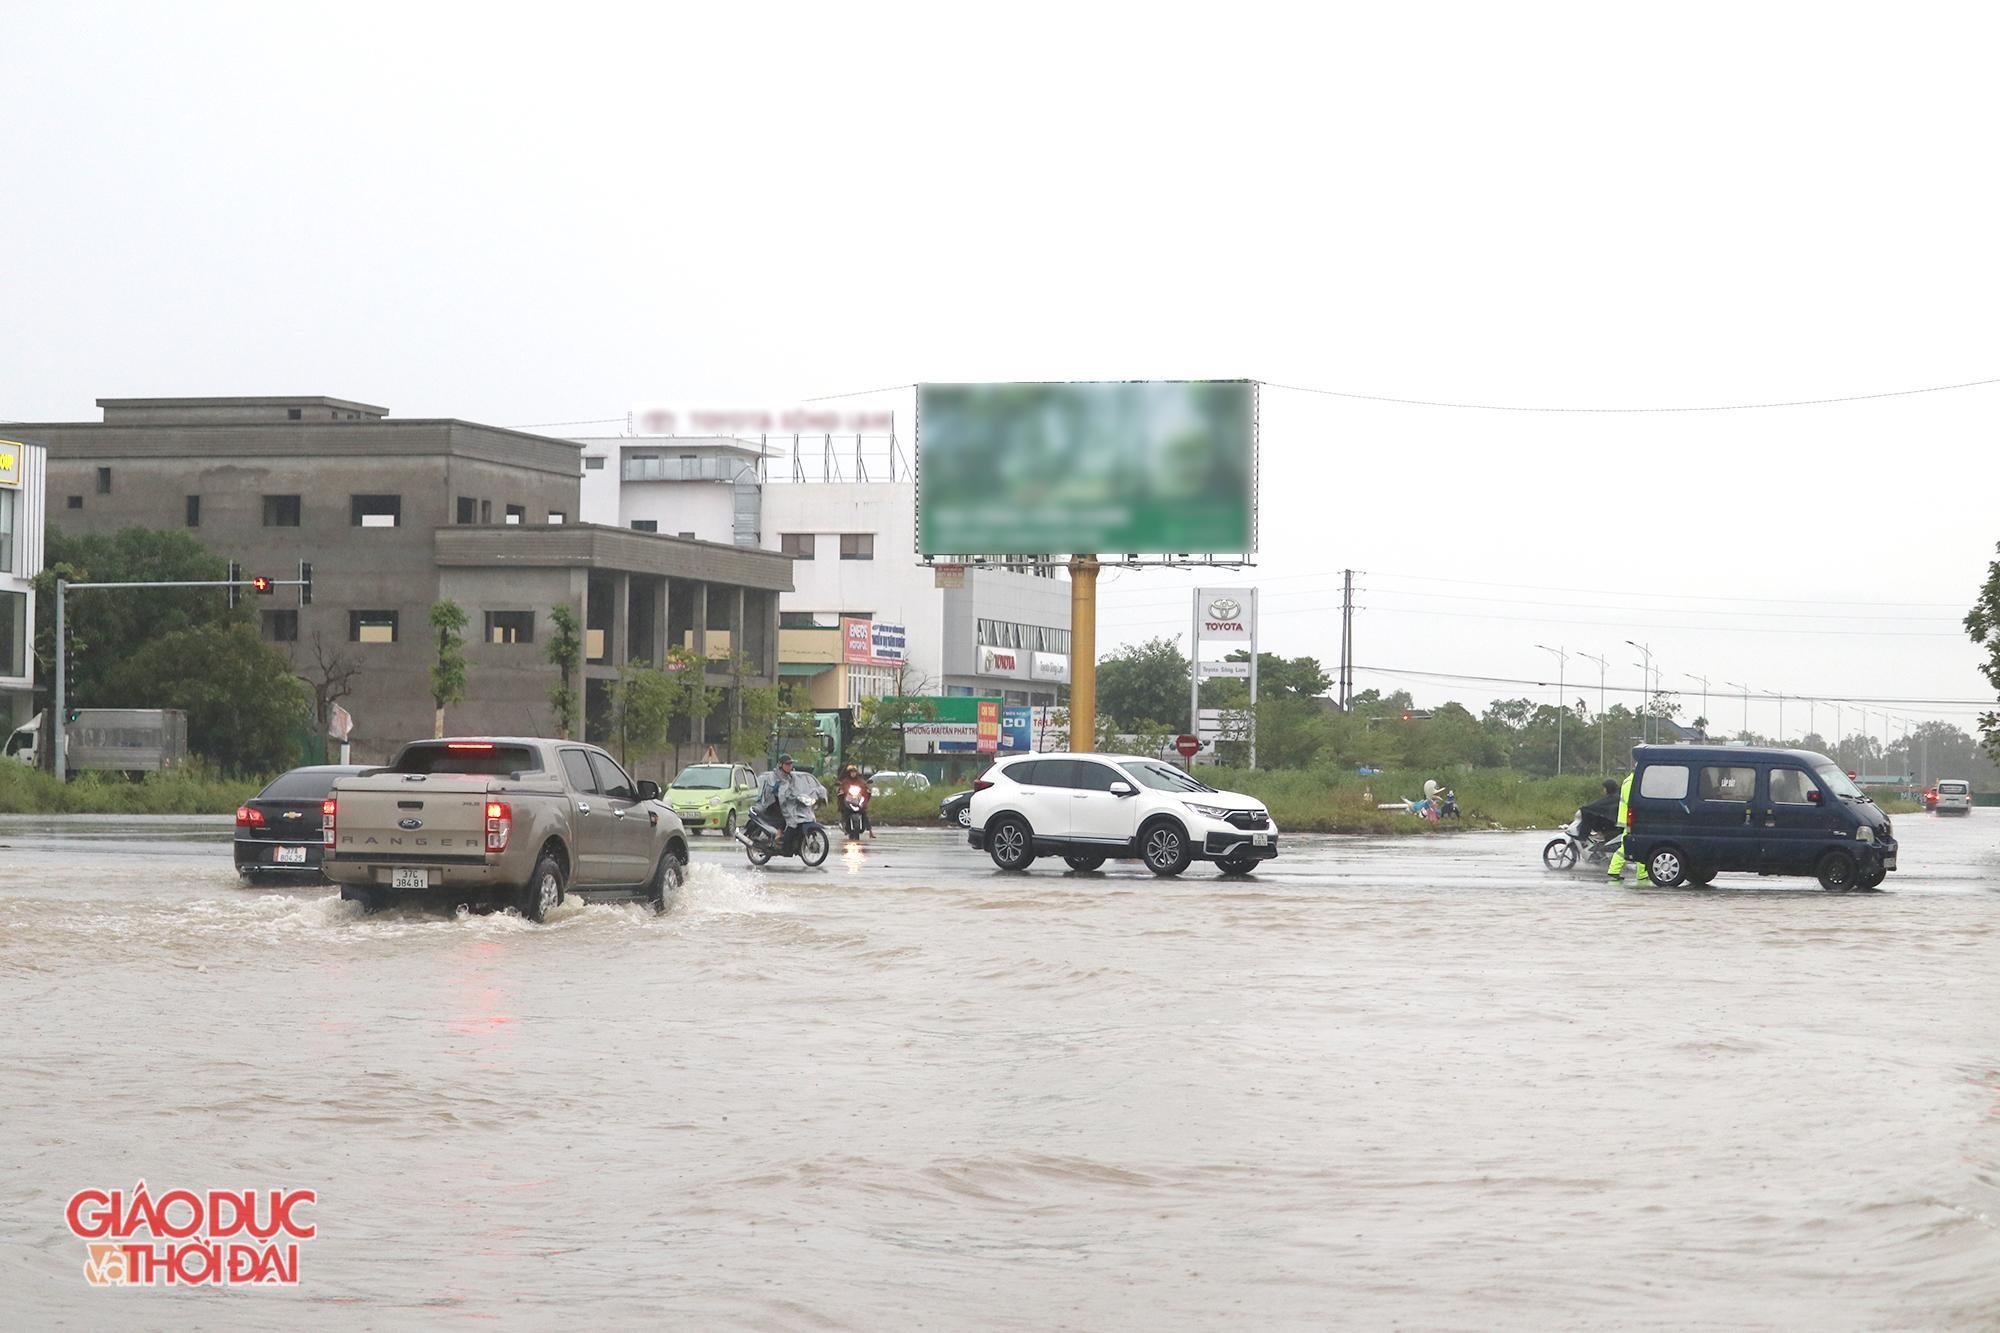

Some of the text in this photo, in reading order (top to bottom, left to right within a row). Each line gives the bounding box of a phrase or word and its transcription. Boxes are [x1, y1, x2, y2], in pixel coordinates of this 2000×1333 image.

[1205, 622, 1243, 632] TOYOTA
[993, 653, 1016, 671] TOYOTA
[341, 836, 479, 848] RANGER
[402, 869, 418, 878] 37C
[396, 879, 424, 888] 384.81
